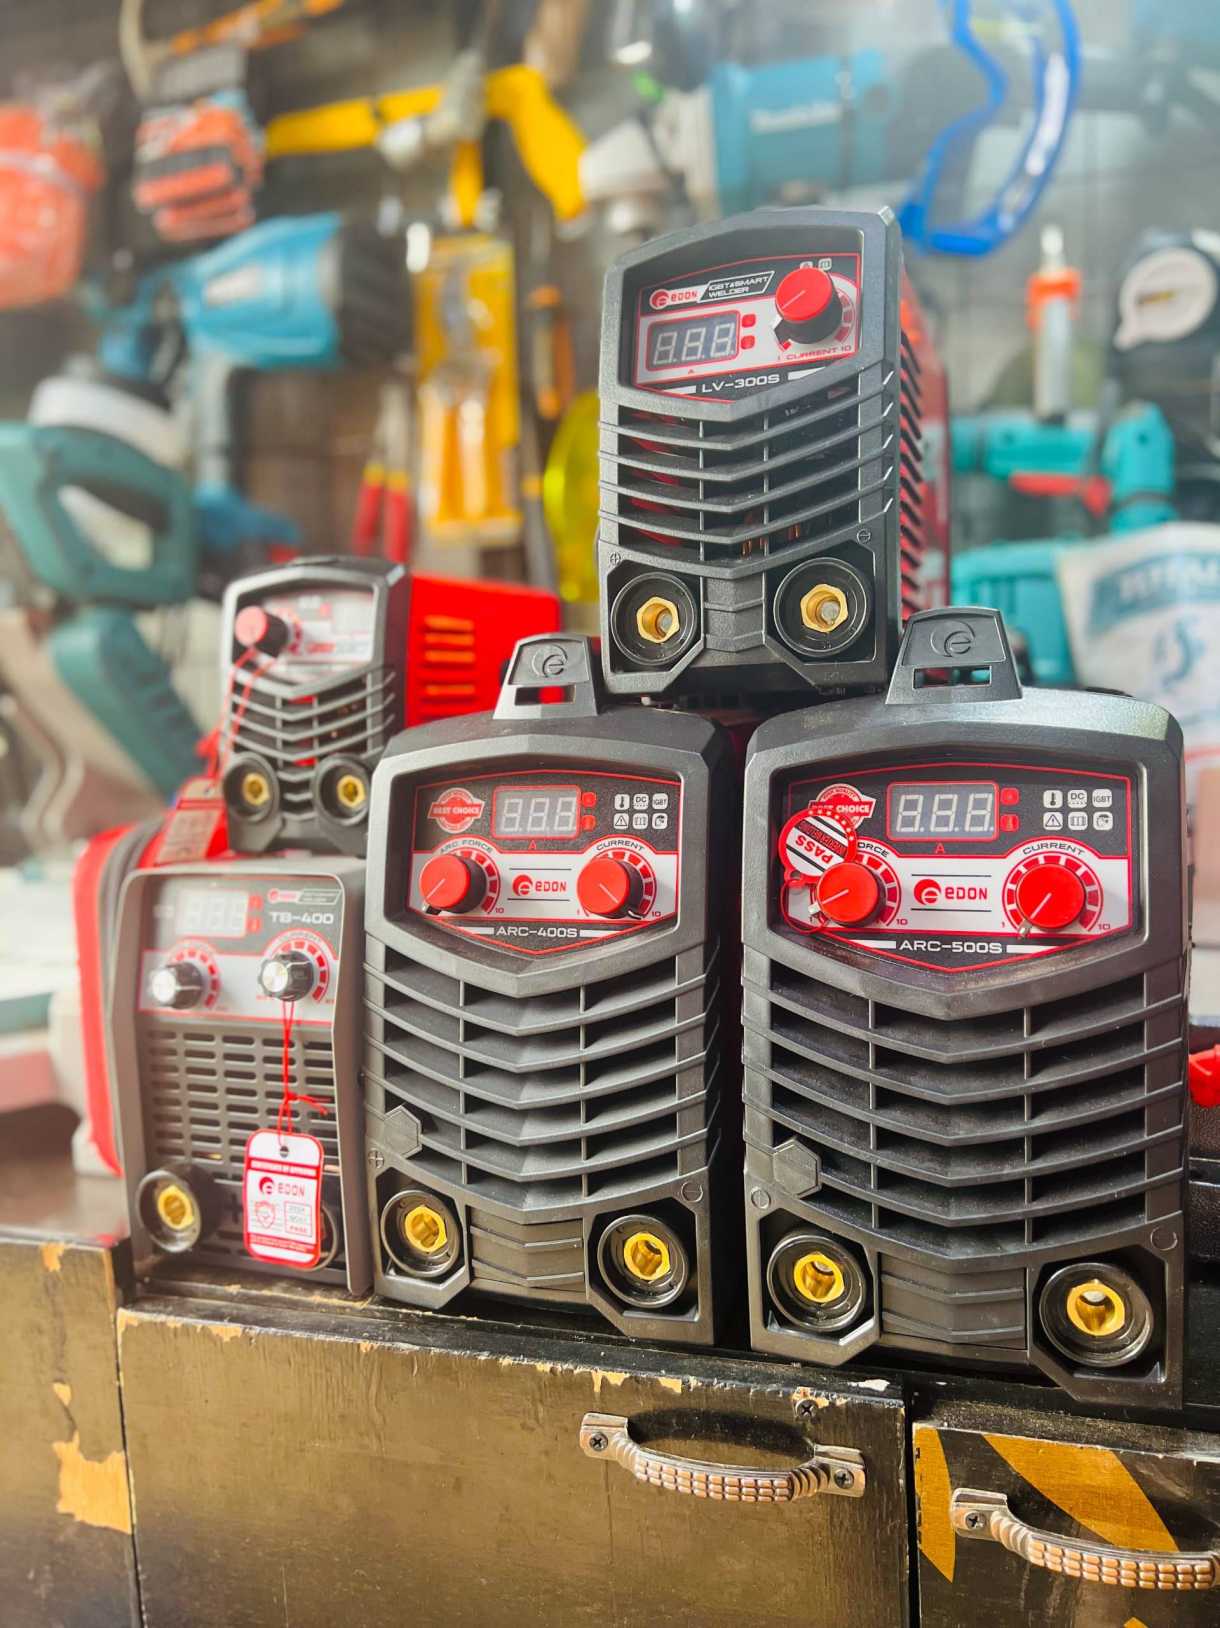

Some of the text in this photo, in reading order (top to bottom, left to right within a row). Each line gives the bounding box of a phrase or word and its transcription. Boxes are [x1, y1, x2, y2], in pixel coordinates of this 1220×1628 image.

[708, 286, 750, 298] WELDER
[701, 374, 780, 394] LV-300S
[1070, 792, 1085, 800] DC
[1093, 795, 1112, 803] IGBT
[452, 806, 480, 814] CHOICE
[836, 804, 870, 813] CHOICE
[462, 839, 493, 853] FORCE
[596, 839, 645, 851] CURRENT
[795, 834, 834, 864] PASS
[857, 841, 890, 857] ORCE
[935, 843, 945, 853] A
[1022, 842, 1085, 856] CURRENT
[269, 911, 334, 924] TB-400
[496, 925, 578, 938] ARC-400S
[900, 939, 1003, 954] ARC-500S
